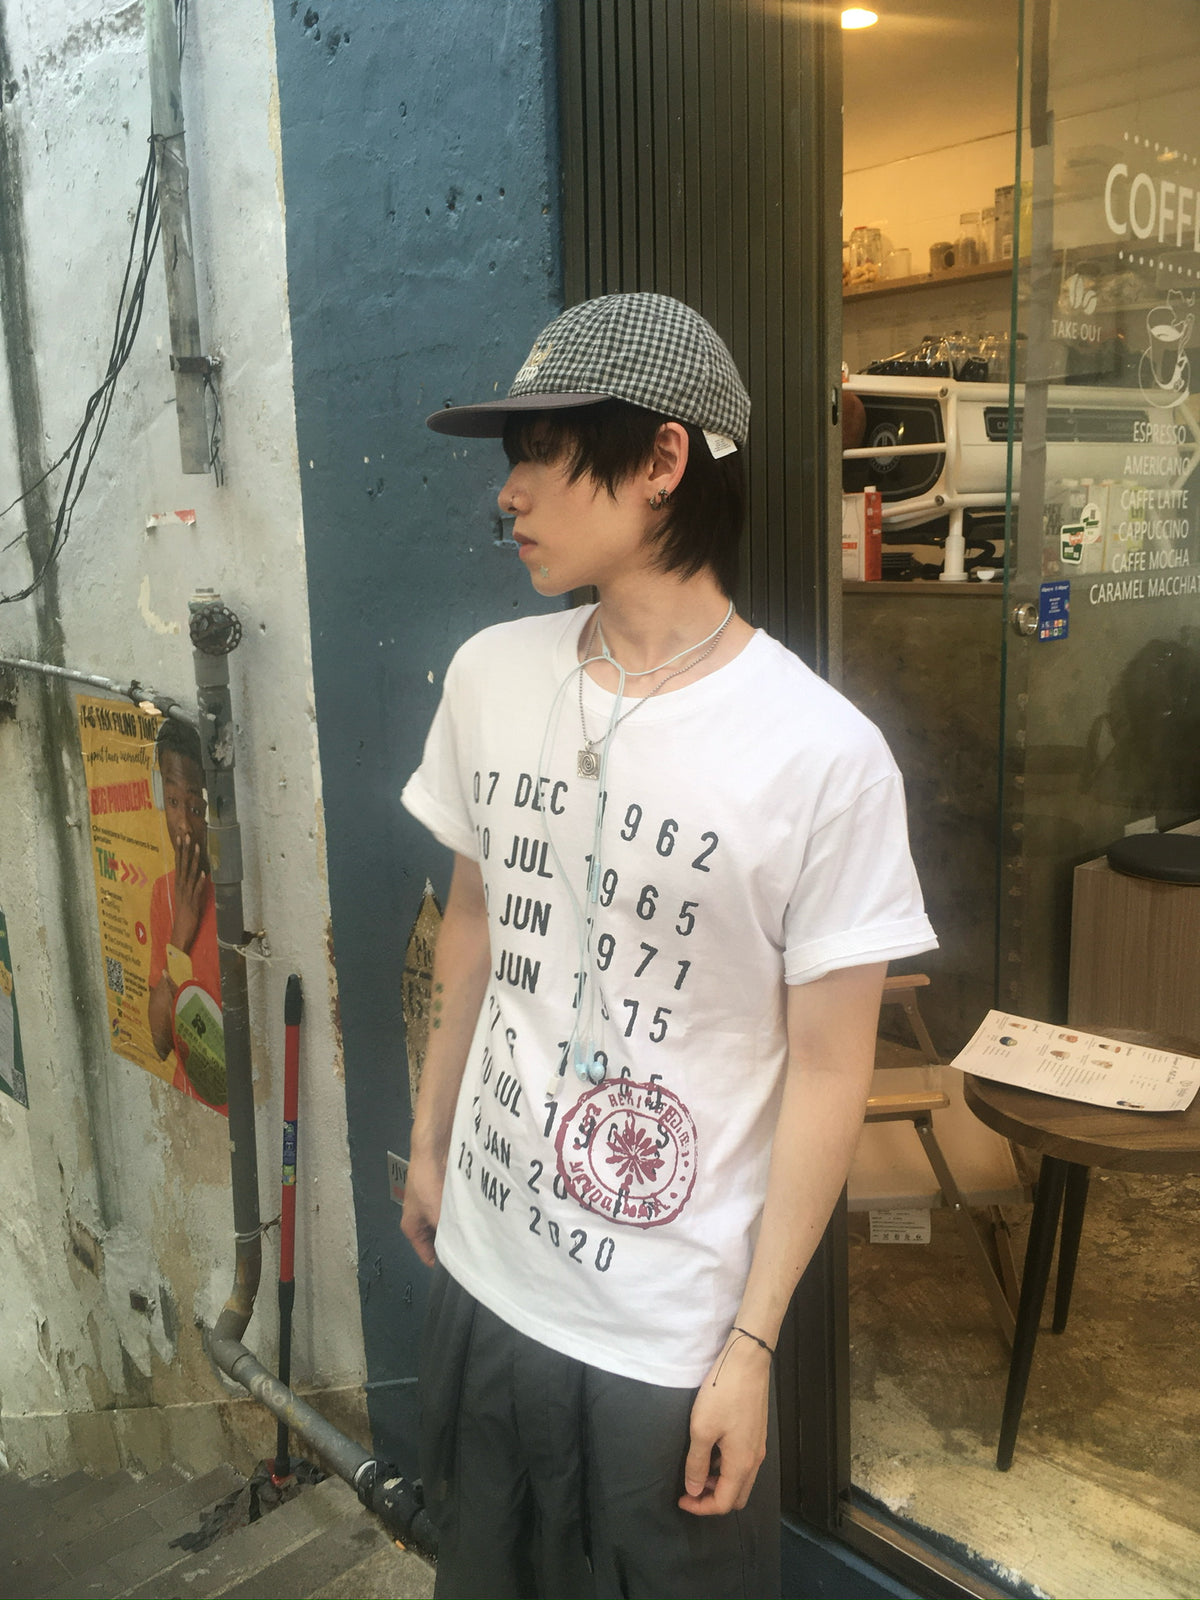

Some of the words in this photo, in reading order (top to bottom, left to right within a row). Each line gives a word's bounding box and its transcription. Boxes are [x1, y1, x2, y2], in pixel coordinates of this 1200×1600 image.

[1052, 319, 1077, 339] TAKE
[1080, 322, 1101, 342] OUT
[1133, 421, 1187, 444] ESPRESSO
[1123, 455, 1190, 476] AMERICANO
[1120, 489, 1155, 510] CAFFE
[1157, 489, 1189, 509] LATTE
[1118, 519, 1190, 541] CAPPUCCINO
[1112, 554, 1146, 573] CAFFE
[1149, 549, 1190, 570] MOCHA
[1089, 579, 1145, 605] CARAMEL
[112, 711, 137, 738] FILING
[473, 771, 500, 805] 07
[514, 773, 568, 815] DEC
[504, 835, 553, 879] JUL
[499, 893, 552, 936] JUN
[495, 950, 541, 994] JUN
[572, 972, 672, 1043] 175
[494, 1071, 523, 1117] JUL
[483, 1125, 511, 1169] JAN
[458, 1142, 473, 1180] 13
[481, 1167, 511, 1212] MAY
[529, 1206, 615, 1272] 2020
